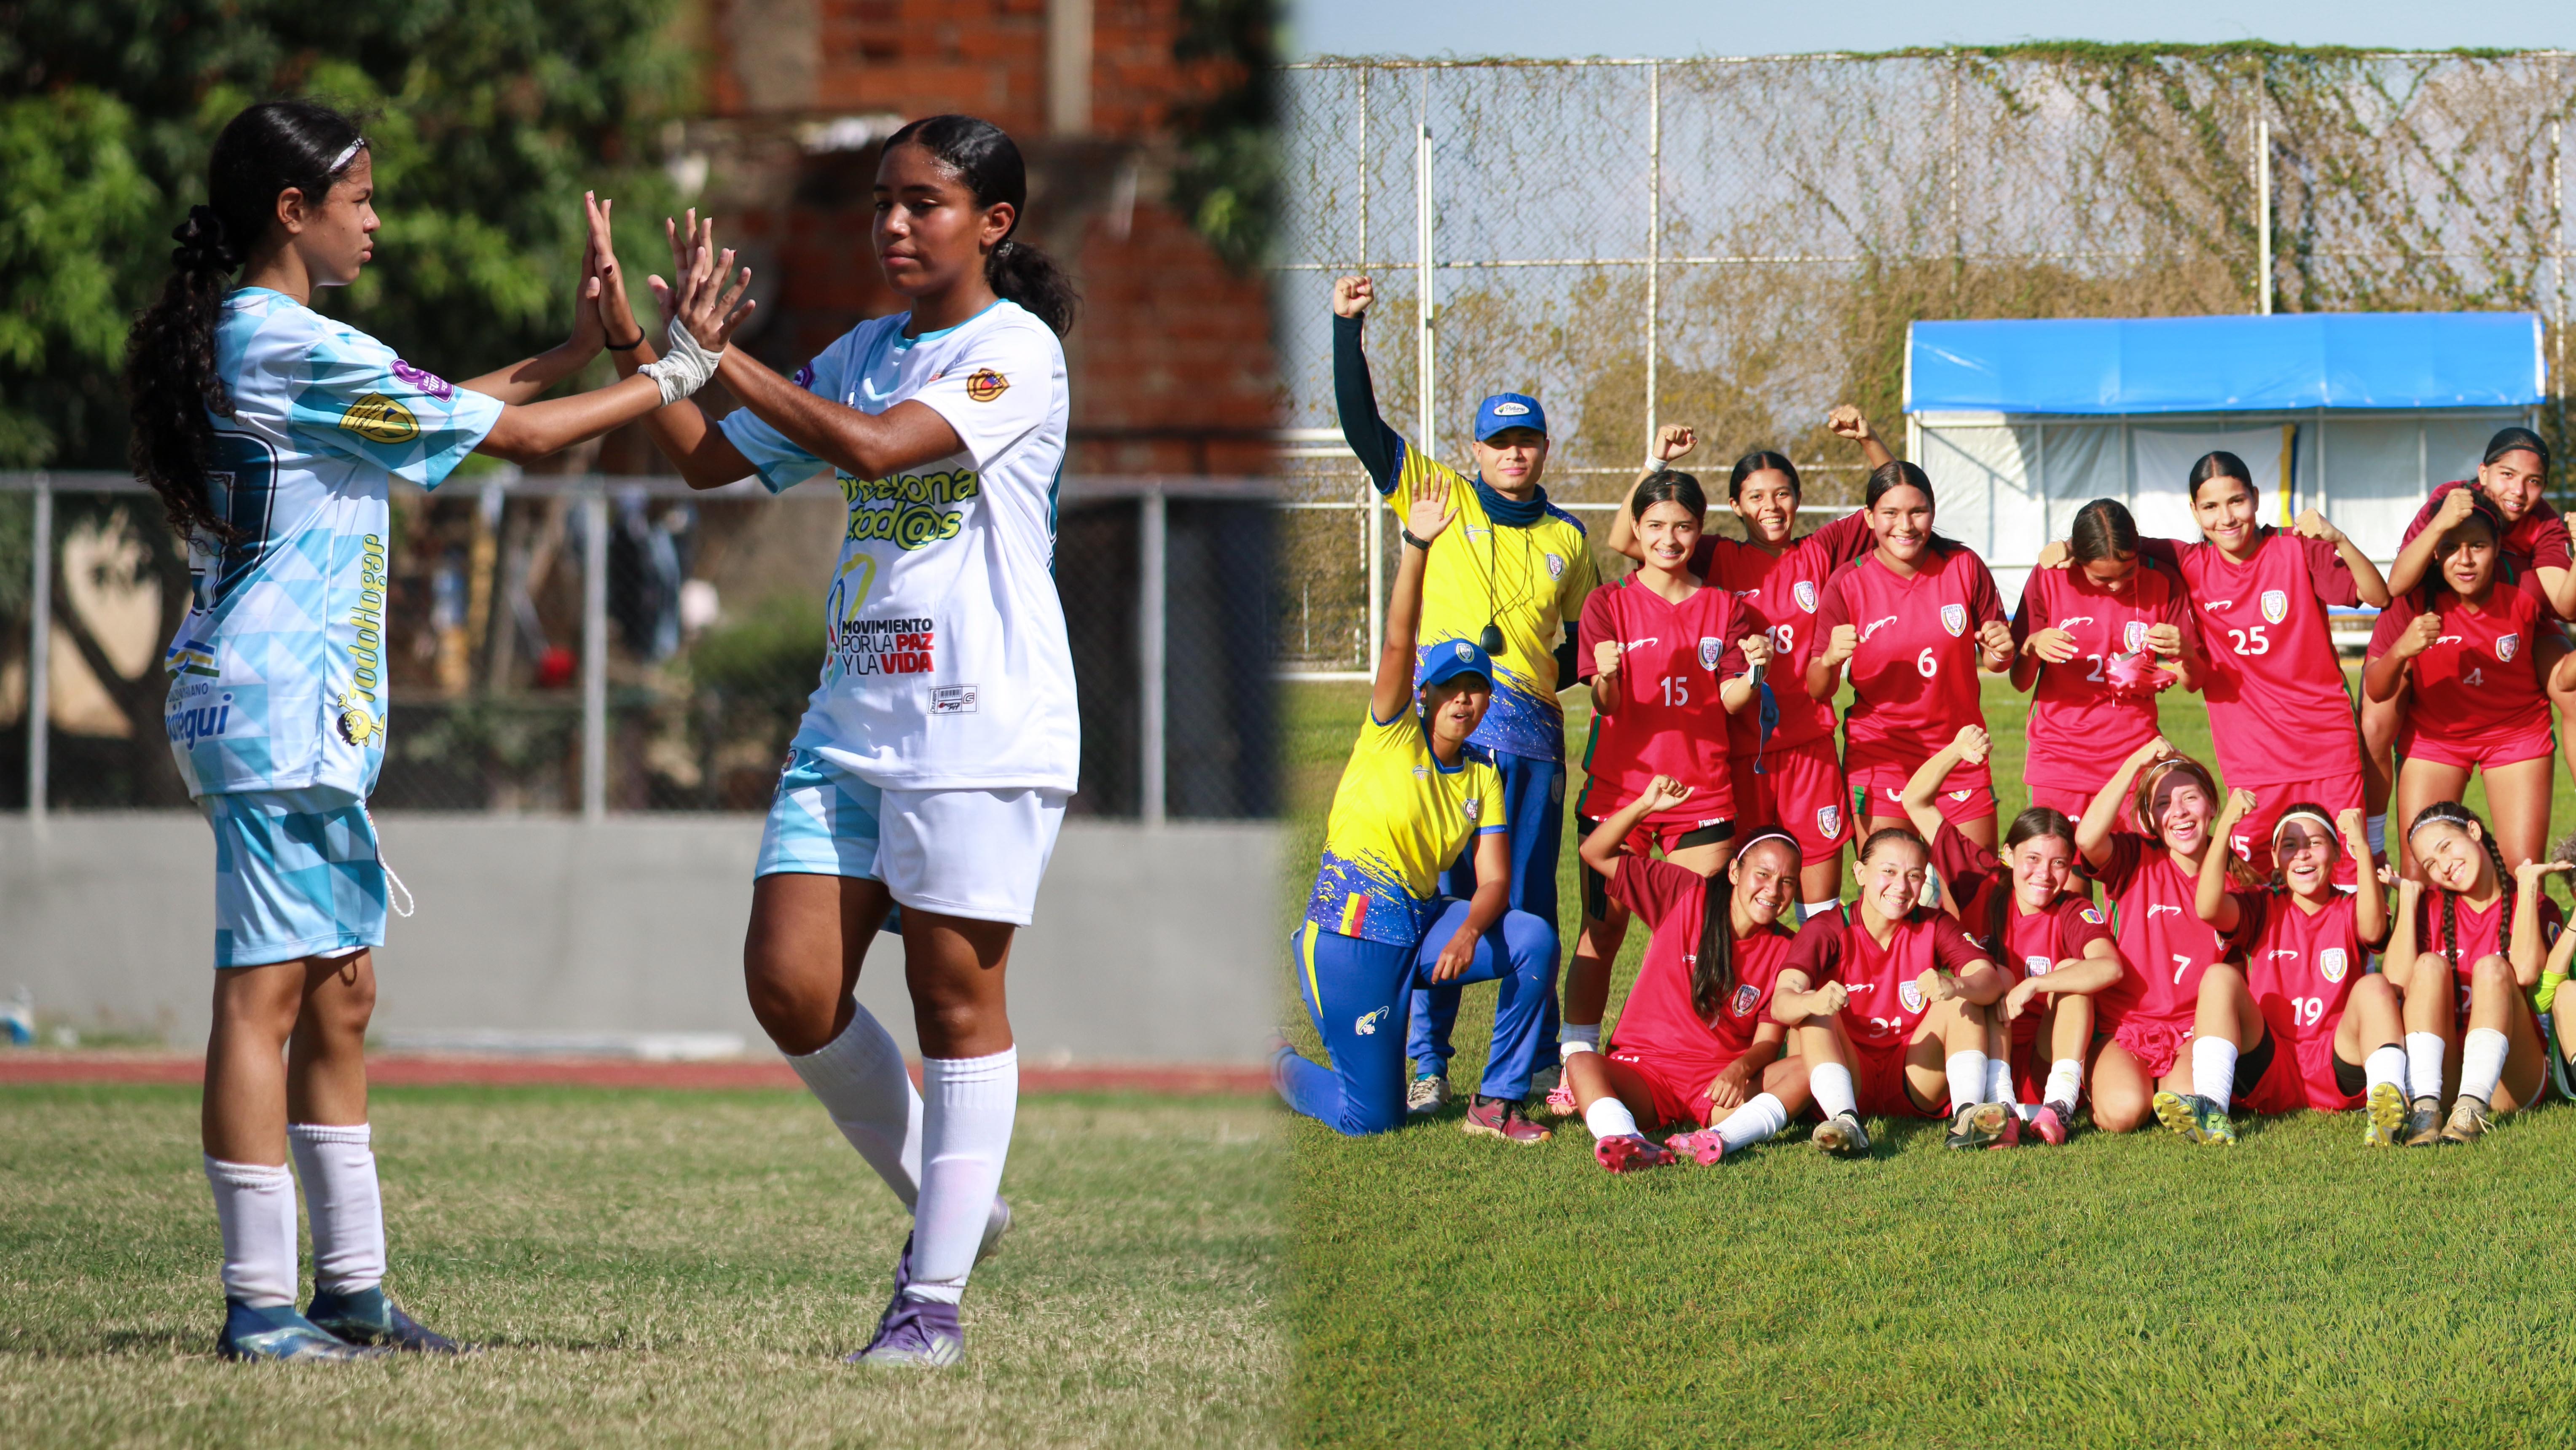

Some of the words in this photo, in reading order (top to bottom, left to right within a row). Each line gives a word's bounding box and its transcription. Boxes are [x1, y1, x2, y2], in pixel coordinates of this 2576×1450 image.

[842, 618, 934, 634] MOVIMIENTO
[1765, 624, 1794, 654] 18
[842, 635, 872, 653] POR
[873, 634, 894, 652] LA
[896, 633, 934, 652] PAZ
[2227, 626, 2270, 655] 25
[842, 655, 853, 675] Y
[857, 654, 880, 675] LA
[880, 652, 934, 674] VIDA
[1918, 647, 1937, 678] 6
[1661, 676, 1688, 706] 15
[2463, 668, 2484, 686] 4
[2230, 835, 2251, 862] 5
[2172, 953, 2192, 985] 7
[2291, 996, 2323, 1027] 19
[1869, 1016, 1902, 1039] 31
